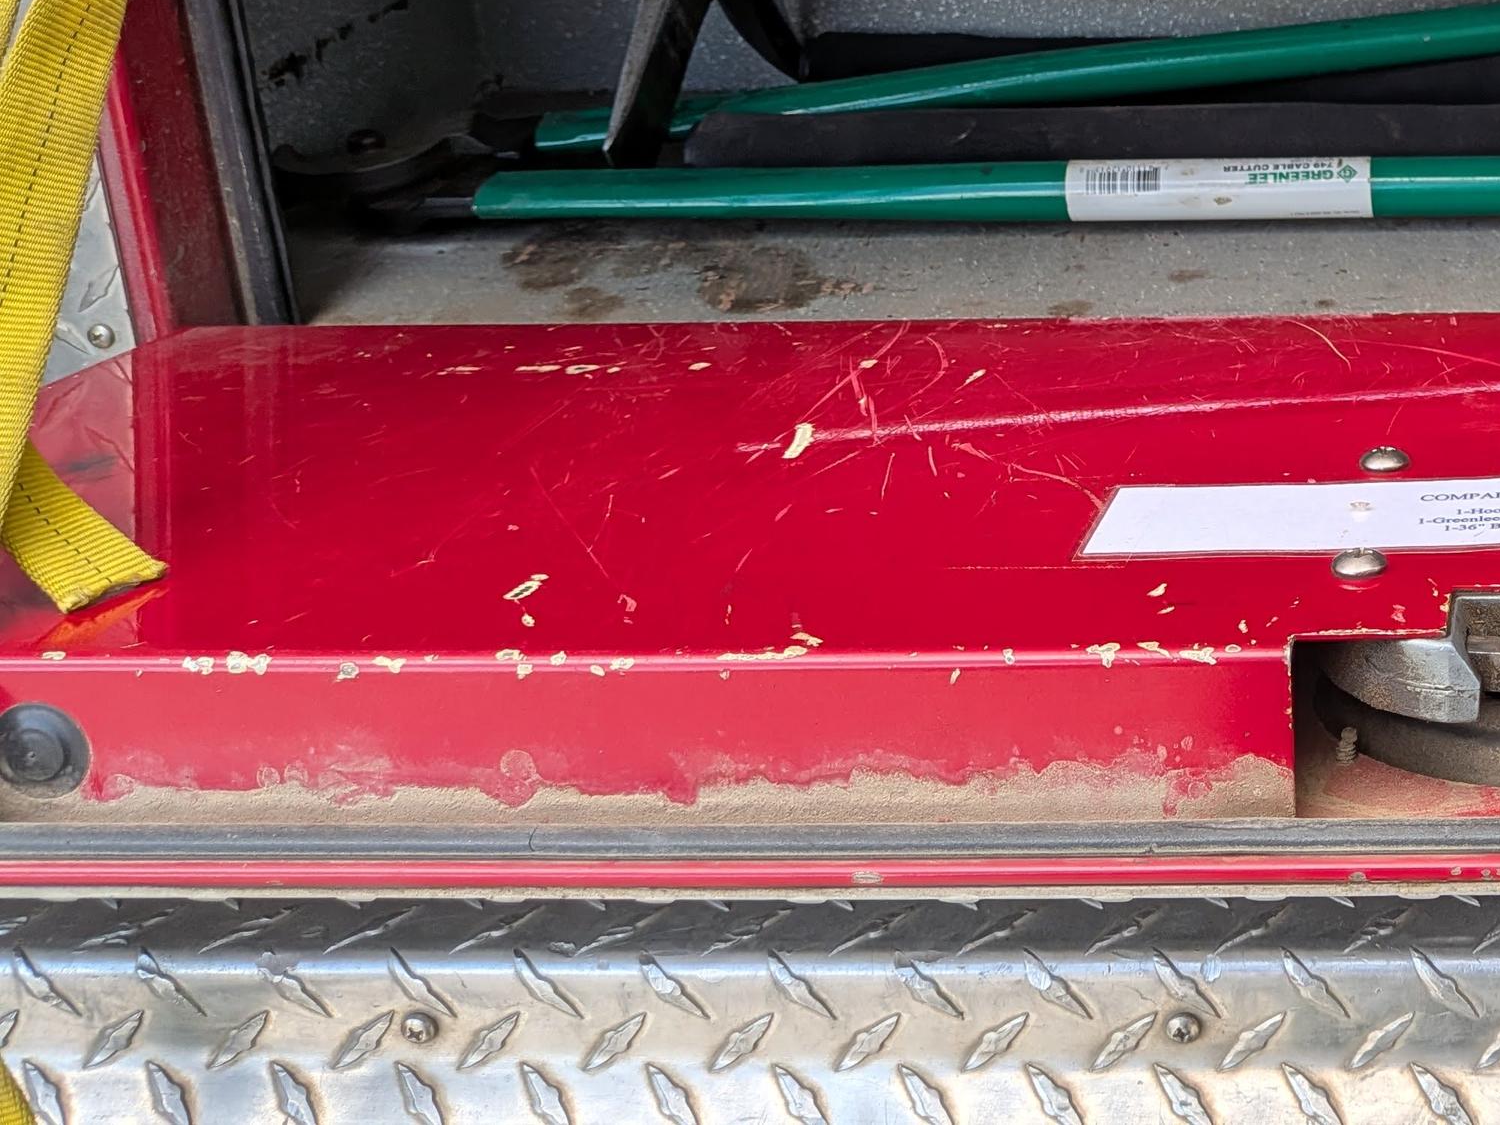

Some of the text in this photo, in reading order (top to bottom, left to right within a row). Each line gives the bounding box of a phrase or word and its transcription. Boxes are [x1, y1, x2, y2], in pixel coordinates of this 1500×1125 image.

[1223, 162, 1334, 173] 749 CABLE CUTTER
[1248, 170, 1334, 185] GREENLEE
[1419, 515, 1500, 524] 1-Greenlee
